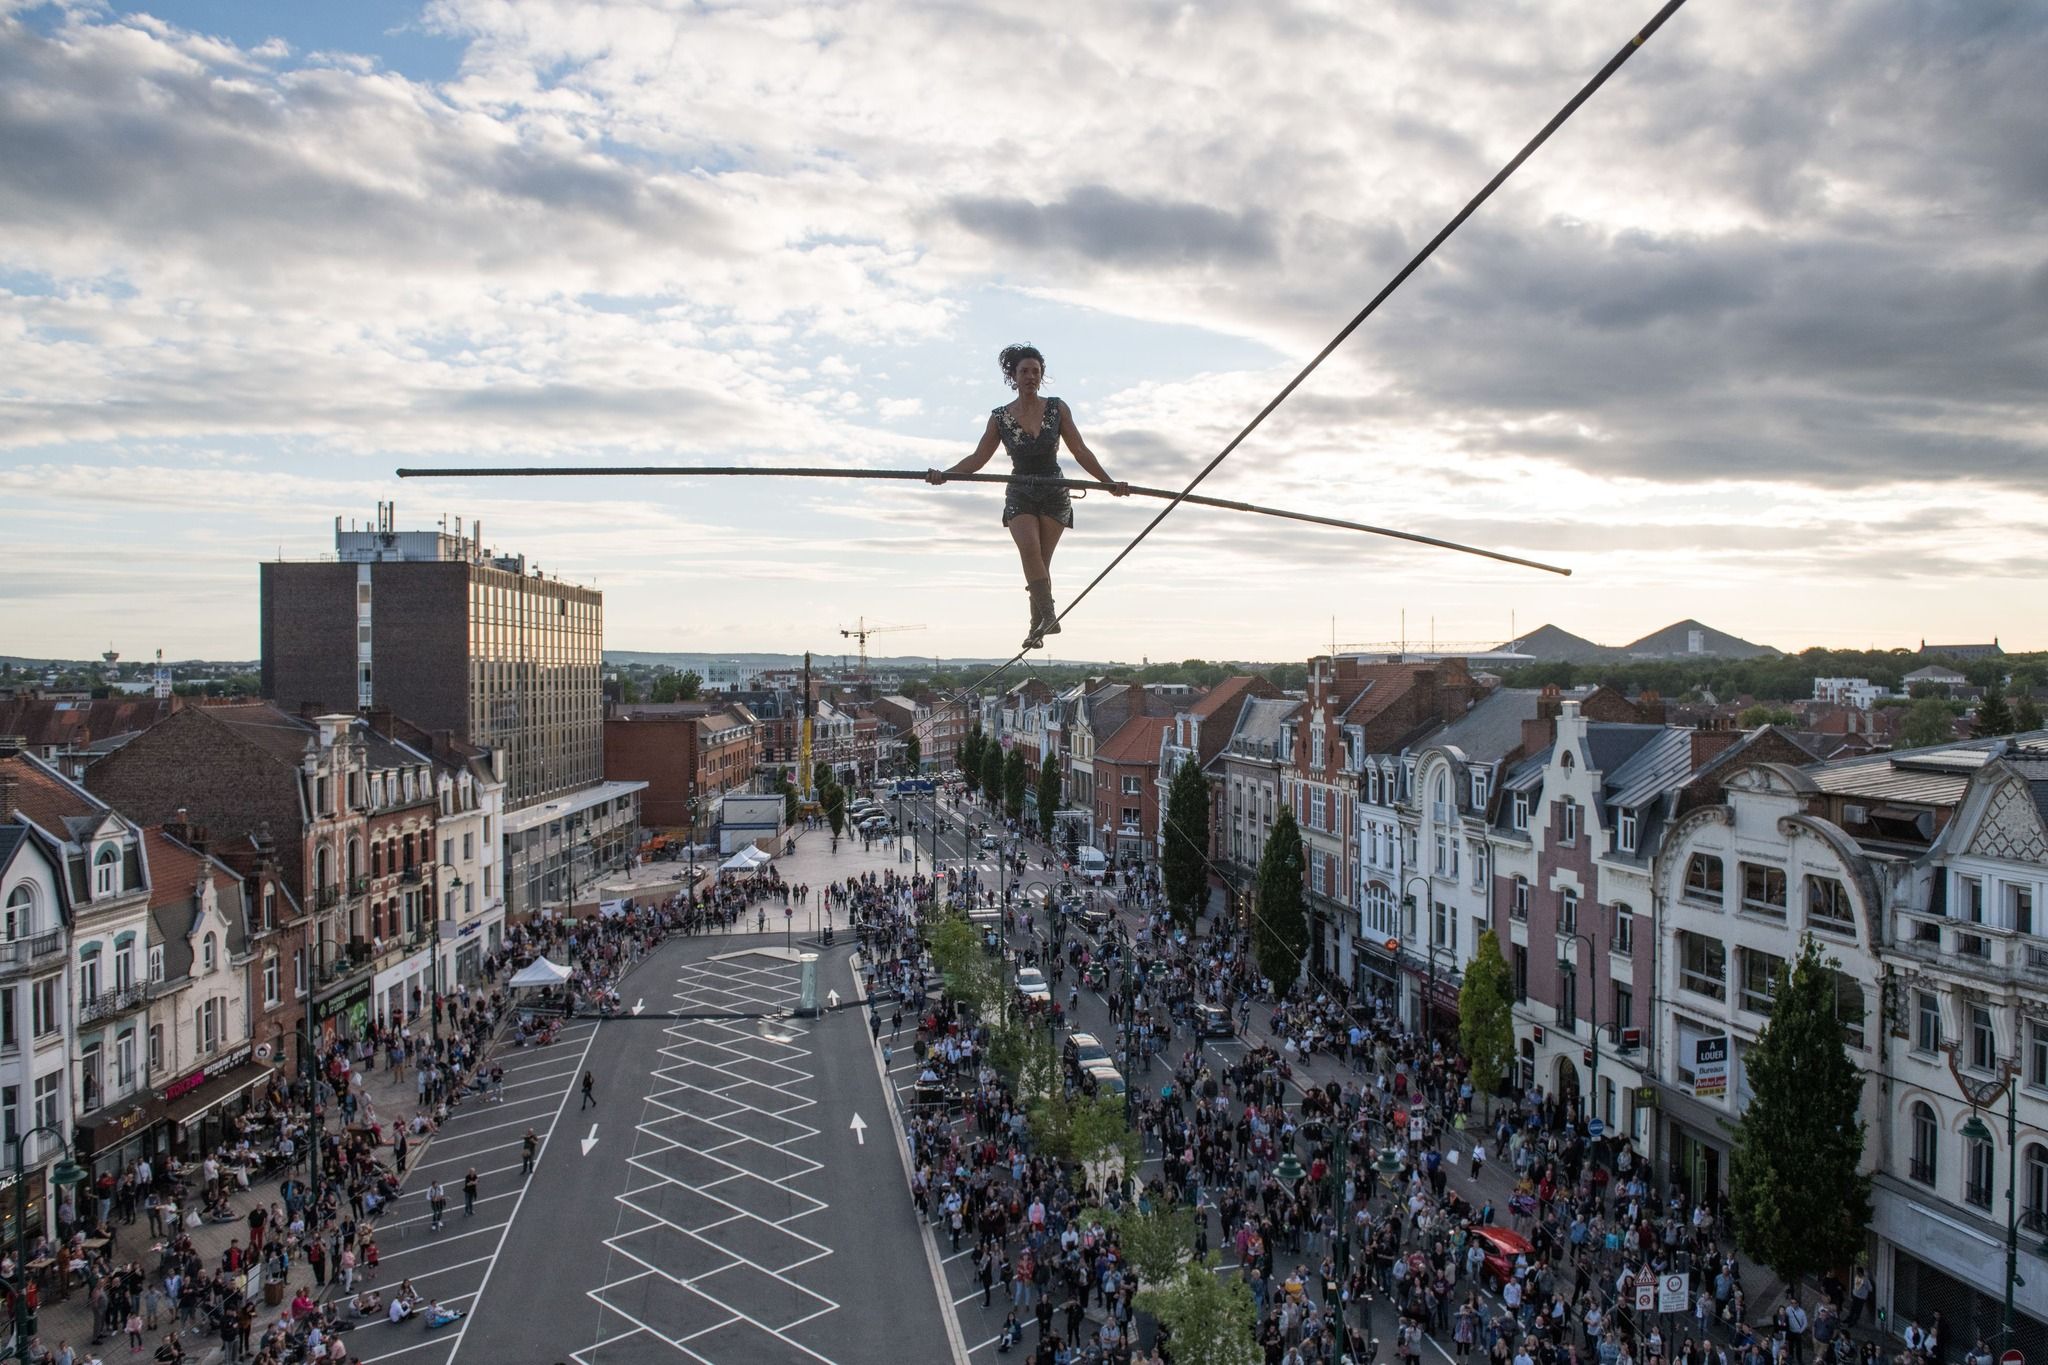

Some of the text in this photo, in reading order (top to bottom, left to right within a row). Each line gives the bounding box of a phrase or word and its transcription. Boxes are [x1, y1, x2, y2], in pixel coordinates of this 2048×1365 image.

[1710, 1041, 1716, 1050] A
[1700, 1050, 1724, 1061] LOUER
[204, 1055, 231, 1076] RESTAURANT
[1699, 1066, 1724, 1075] Bureaux
